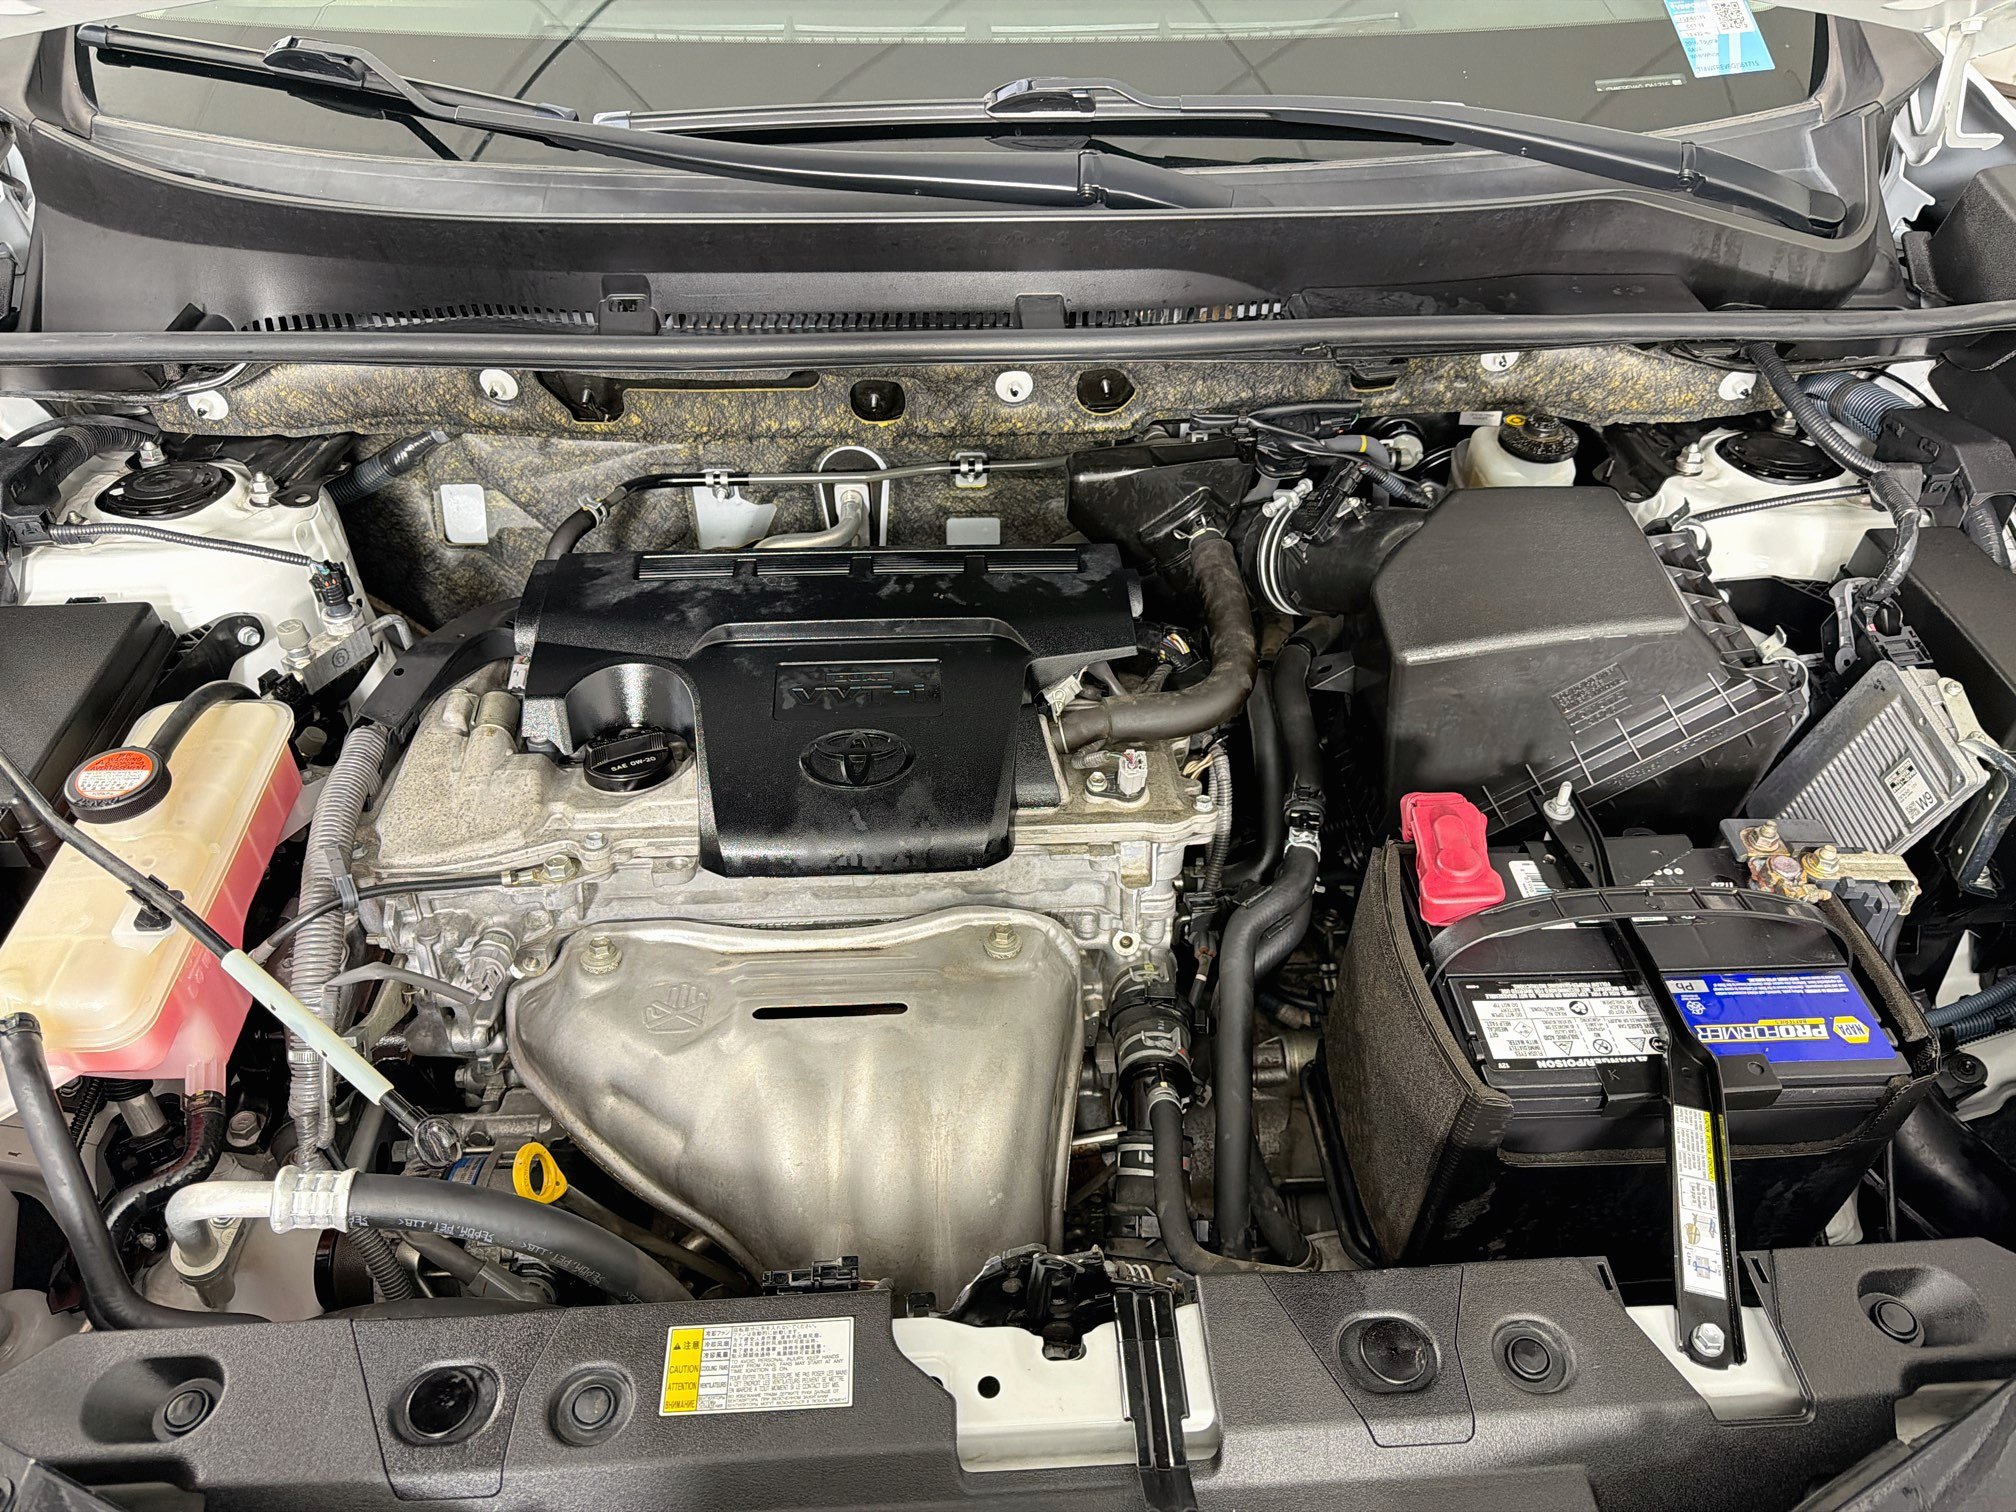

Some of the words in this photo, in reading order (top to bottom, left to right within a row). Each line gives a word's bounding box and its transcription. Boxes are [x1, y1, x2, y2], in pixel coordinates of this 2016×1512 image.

[611, 762, 628, 772] SAE
[1675, 981, 1694, 991] Pb
[1697, 1024, 1827, 1041] PROFORMER
[1837, 1023, 1865, 1036] NAPA
[683, 1340, 700, 1349] 注意
[669, 1364, 698, 1374] CAUTION
[667, 1381, 696, 1390] ATTENTION
